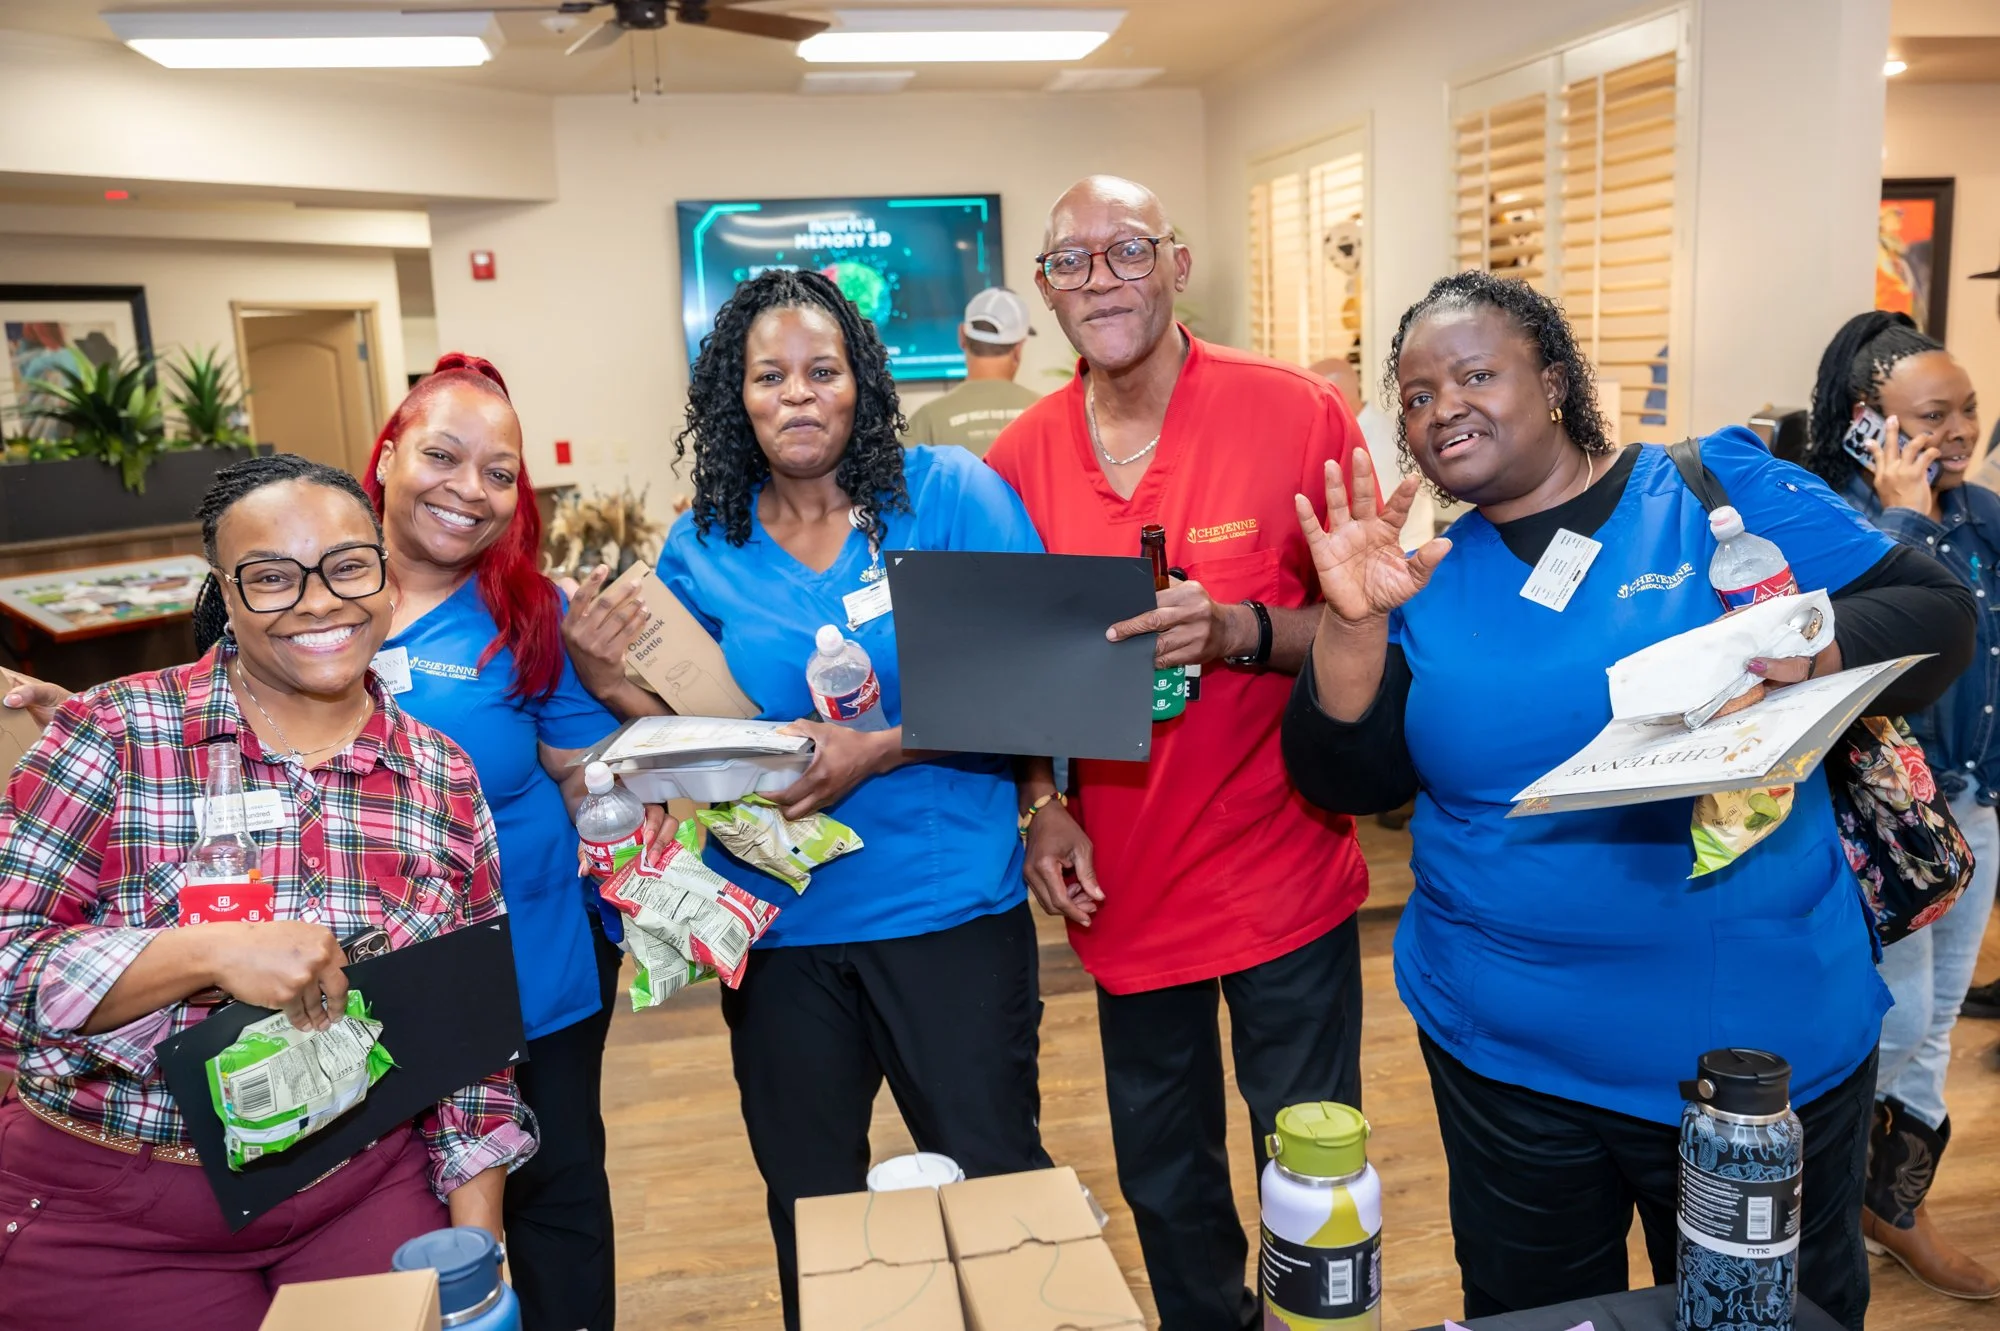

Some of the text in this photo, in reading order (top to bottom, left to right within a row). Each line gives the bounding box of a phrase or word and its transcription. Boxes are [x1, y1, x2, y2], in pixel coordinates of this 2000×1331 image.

[795, 231, 892, 249] MEMORY 3D
[1197, 519, 1257, 538] CHEYENNE
[1630, 563, 1692, 591] CHEYENNE
[1640, 583, 1665, 591] MEDICAL
[628, 620, 665, 651] Outback
[635, 637, 662, 661] Bottle
[418, 660, 479, 677] CHEYENNE
[1565, 745, 1729, 777] CHEYENNE
[346, 1017, 363, 1039] Calories
